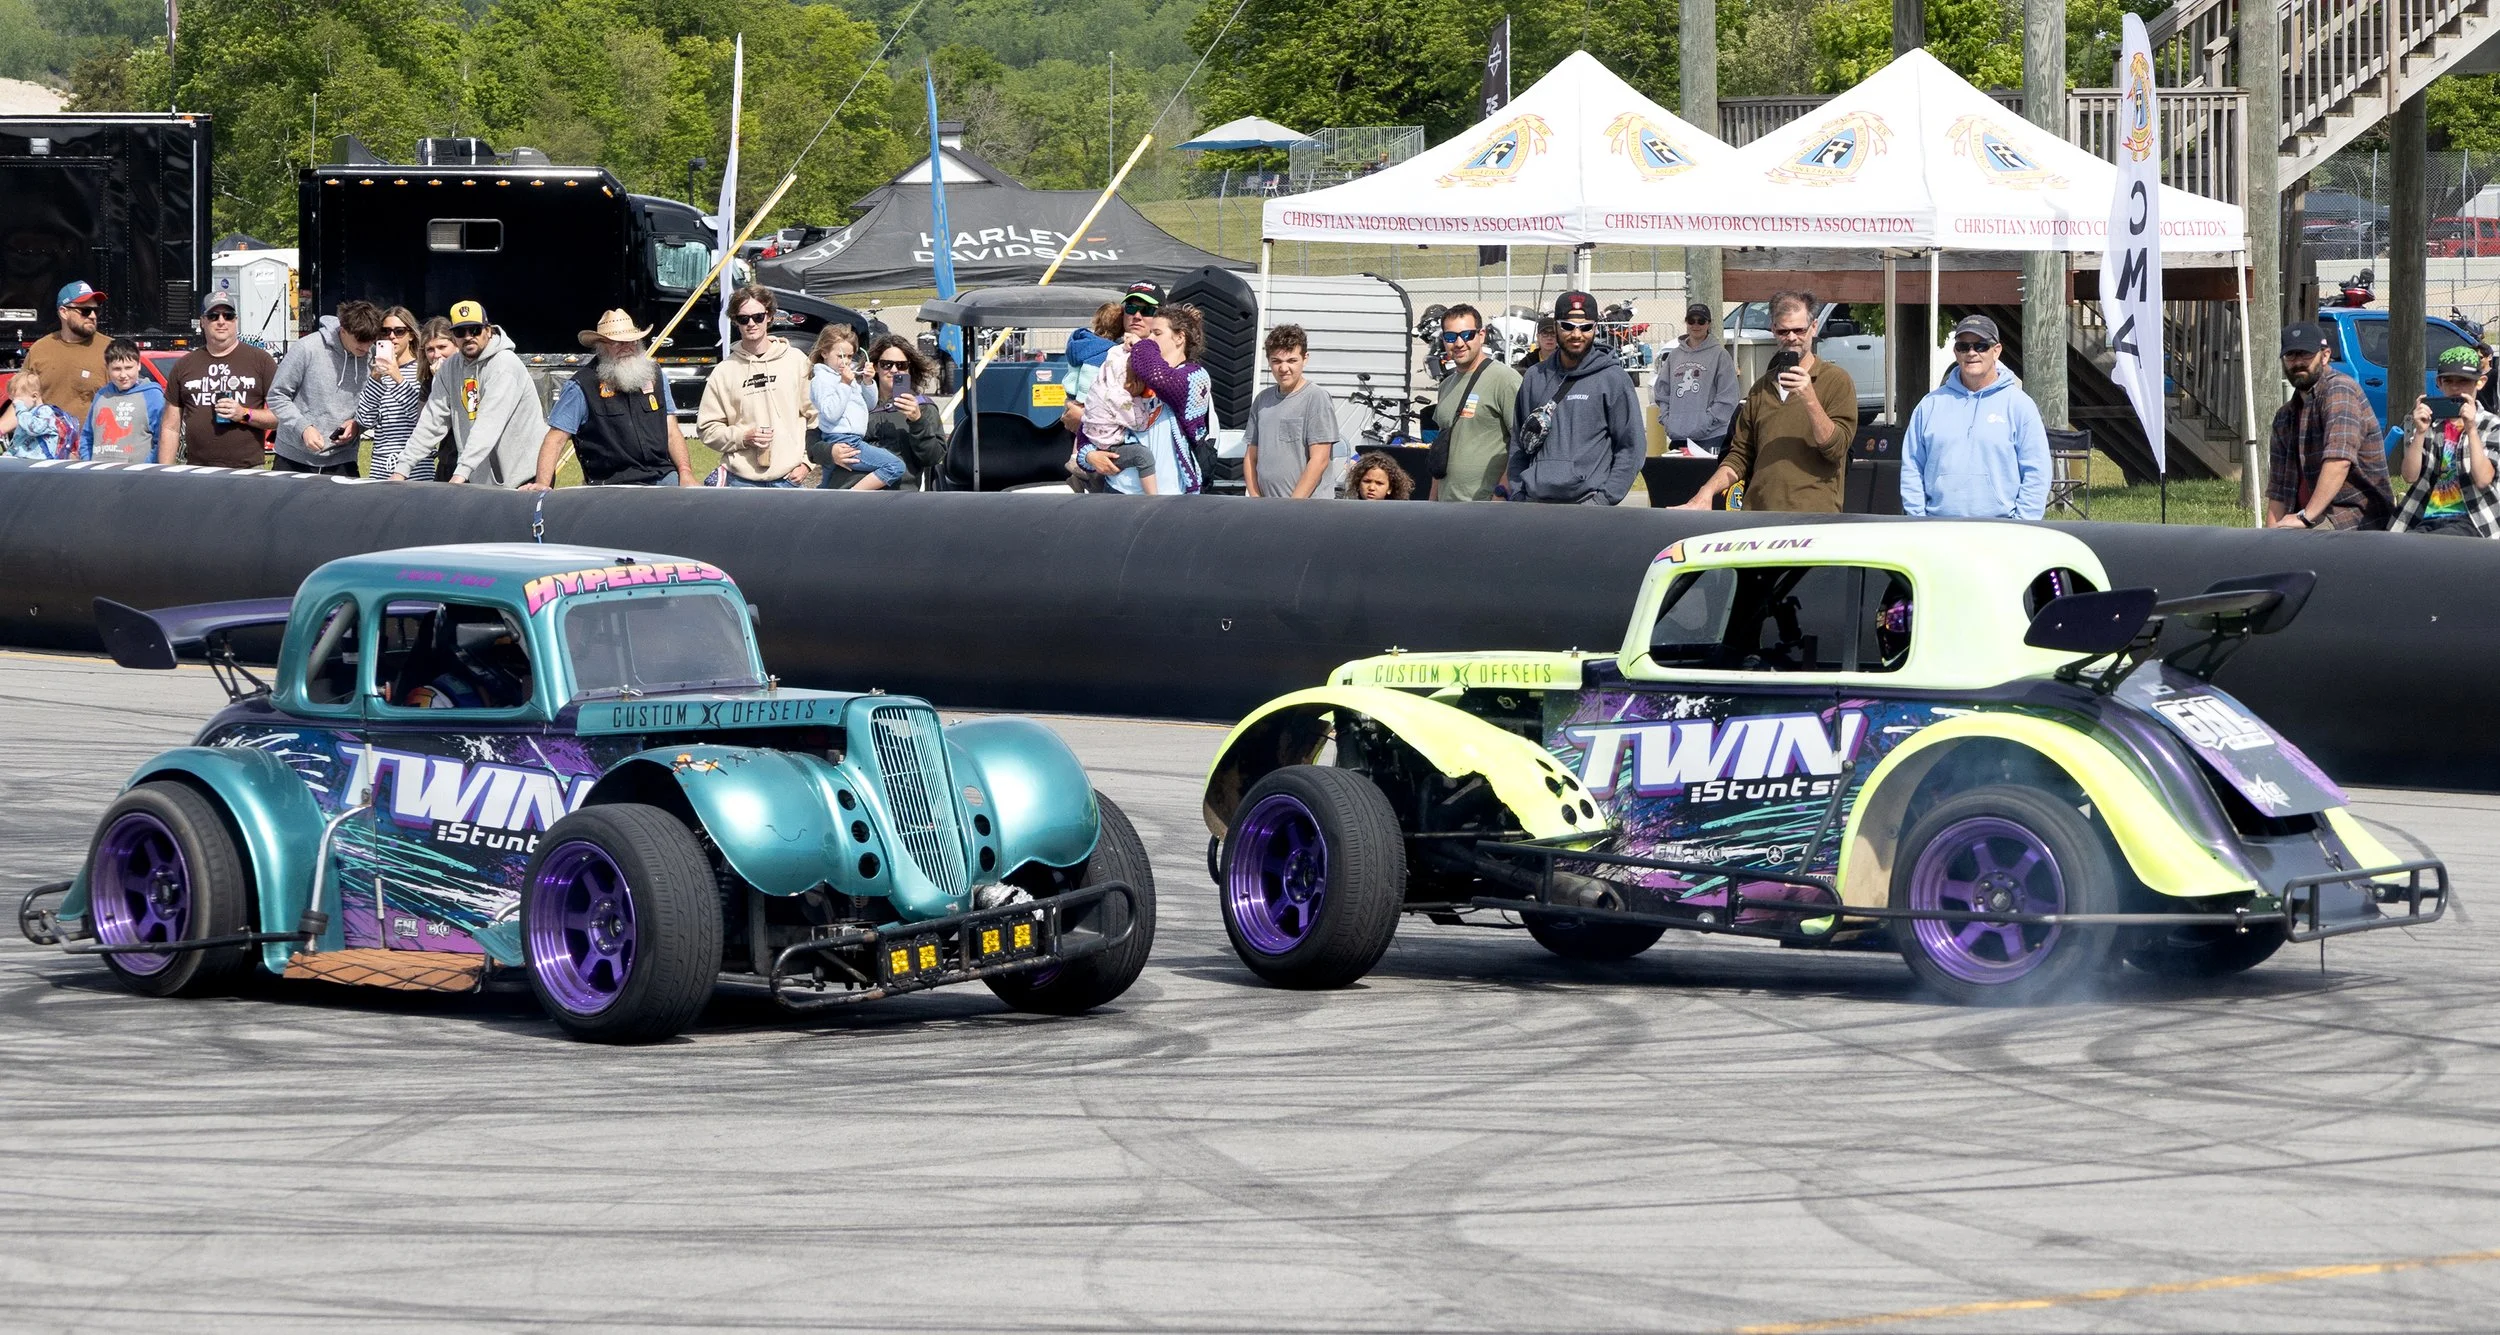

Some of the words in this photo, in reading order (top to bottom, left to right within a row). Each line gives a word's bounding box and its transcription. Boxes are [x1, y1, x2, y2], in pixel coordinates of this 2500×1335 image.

[1282, 210, 1354, 231] CHRISTIAN
[1358, 215, 1470, 232] MOTORCYCLISTS
[1472, 215, 1567, 233] ASSOCIATION
[1604, 213, 1684, 230] CHRISTIAN
[1687, 214, 1810, 232] MOTORCYCLISTS
[1813, 216, 1916, 233] ASSOCIATION
[1954, 217, 2026, 235] CHRISTIAN
[2029, 219, 2108, 236] MOTORCYCL
[208, 363, 231, 376] 0%
[1699, 540, 1764, 554] TWIN
[522, 562, 736, 618] HYPERFES
[1375, 664, 1440, 683] CUSTOM
[1479, 663, 1552, 683] OFFSETS
[613, 703, 688, 728] CUSTOM
[732, 699, 817, 724] OFFSETS
[1571, 713, 1864, 790] TWIN
[337, 743, 598, 832] TWIN
[1699, 778, 1831, 803] Stunts
[445, 822, 541, 853] Stunt
